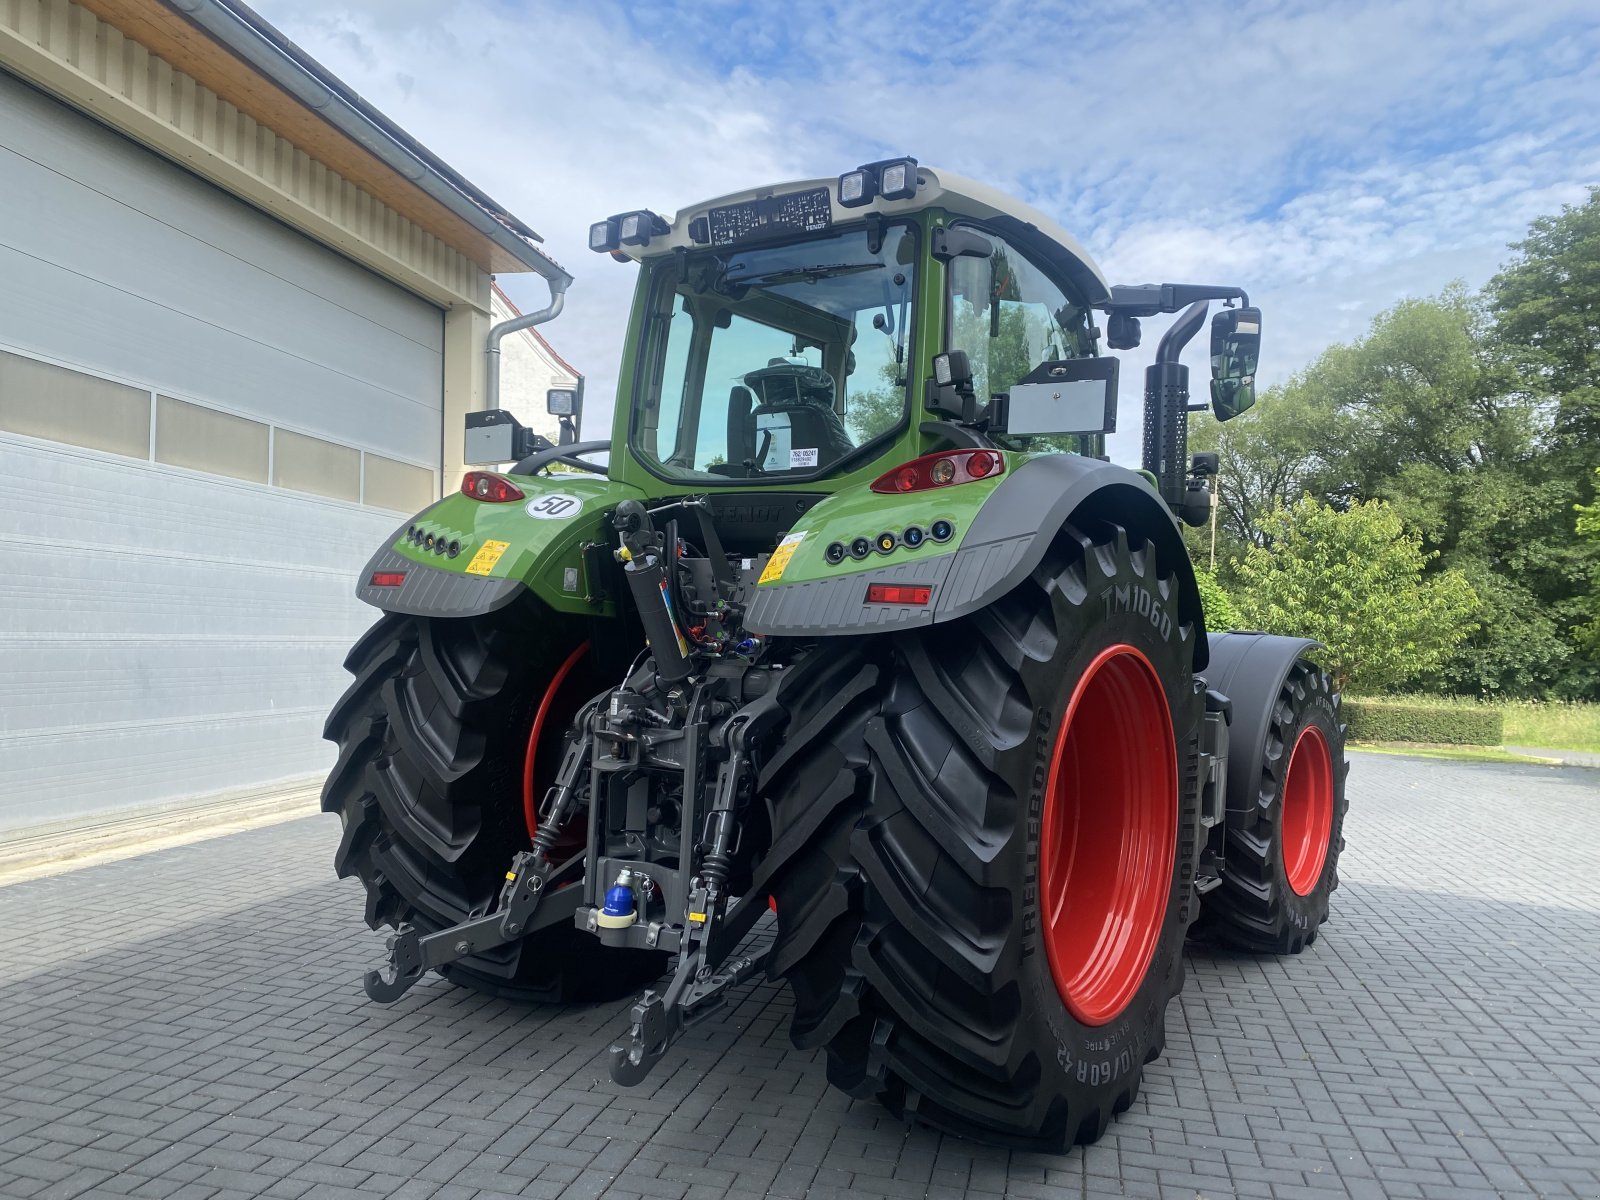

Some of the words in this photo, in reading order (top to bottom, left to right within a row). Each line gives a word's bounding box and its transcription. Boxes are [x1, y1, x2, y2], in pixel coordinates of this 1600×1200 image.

[805, 222, 827, 231] FENDT
[533, 496, 575, 515] 50
[1100, 582, 1172, 643] TM1060
[1019, 707, 1052, 966] TRELLEBORG
[1179, 733, 1199, 924] TRELLEBORG
[1084, 1039, 1104, 1052] TIRE
